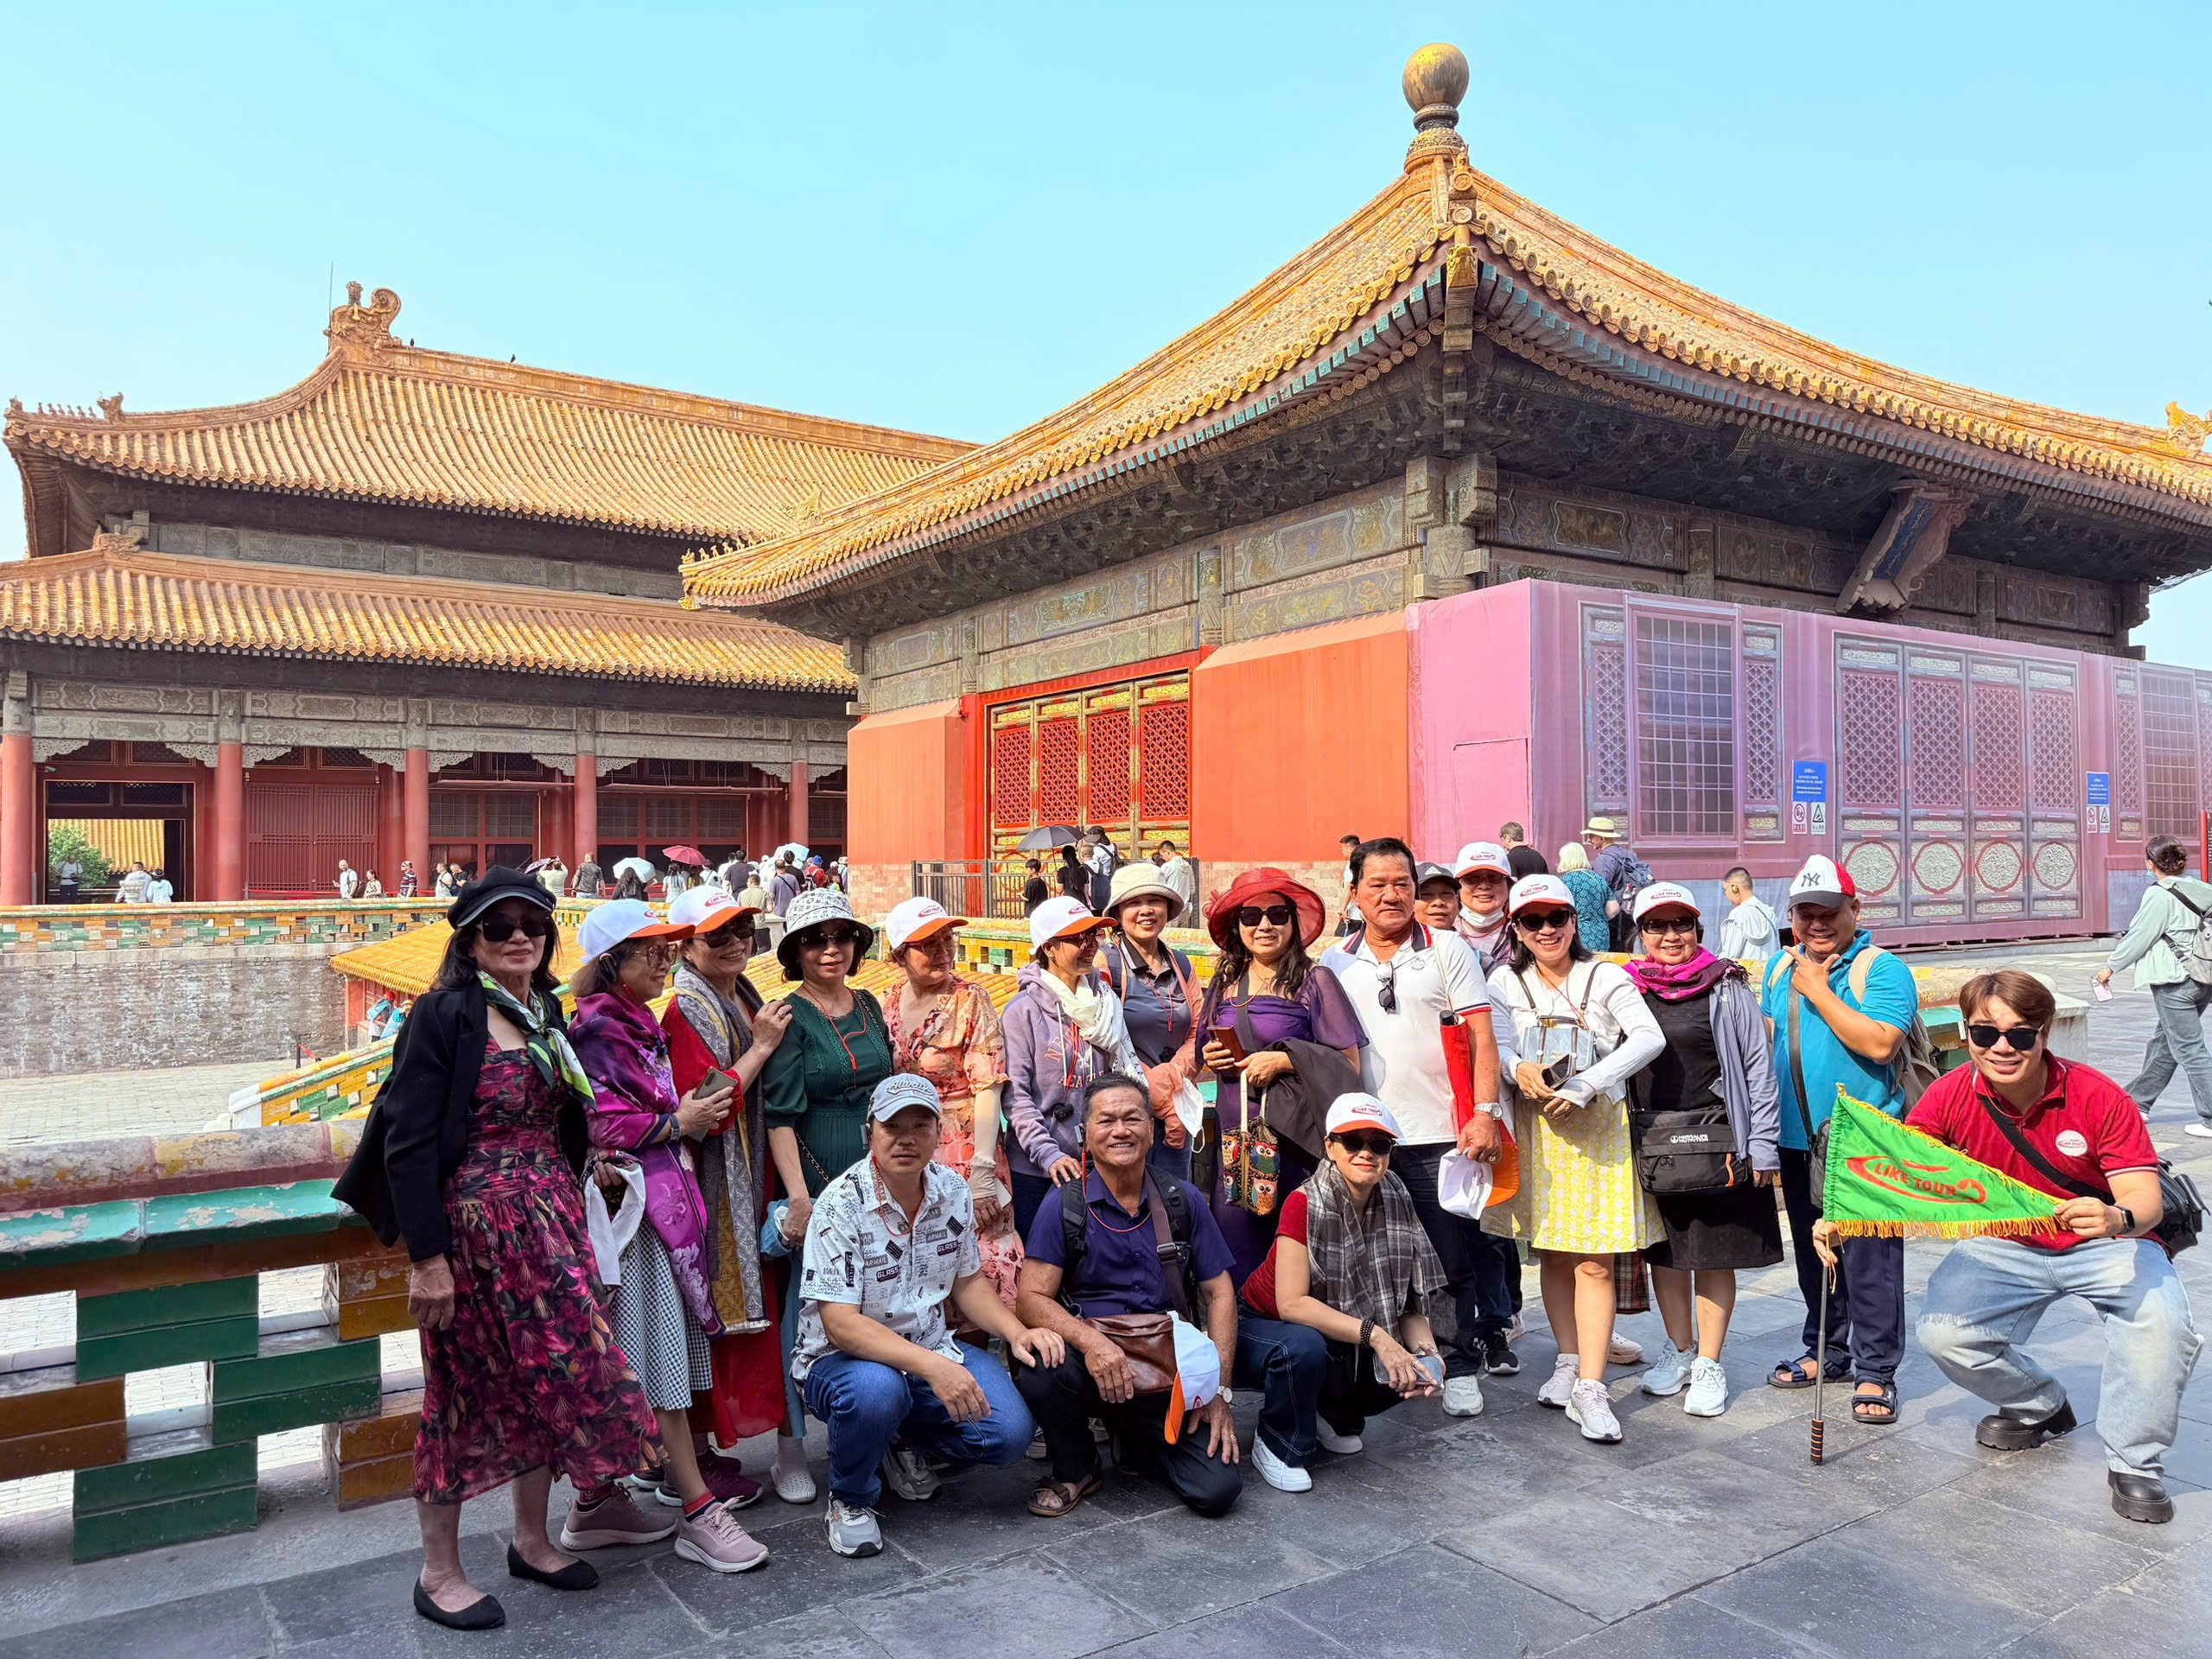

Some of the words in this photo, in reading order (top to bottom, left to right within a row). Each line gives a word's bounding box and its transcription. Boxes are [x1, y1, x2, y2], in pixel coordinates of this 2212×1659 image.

[1801, 873, 1821, 887] NY
[1872, 1162, 1909, 1184] LIKE
[1912, 1177, 1957, 1197] TOUR
[938, 1241, 957, 1252] GLASS
[877, 1266, 899, 1279] GLASS
